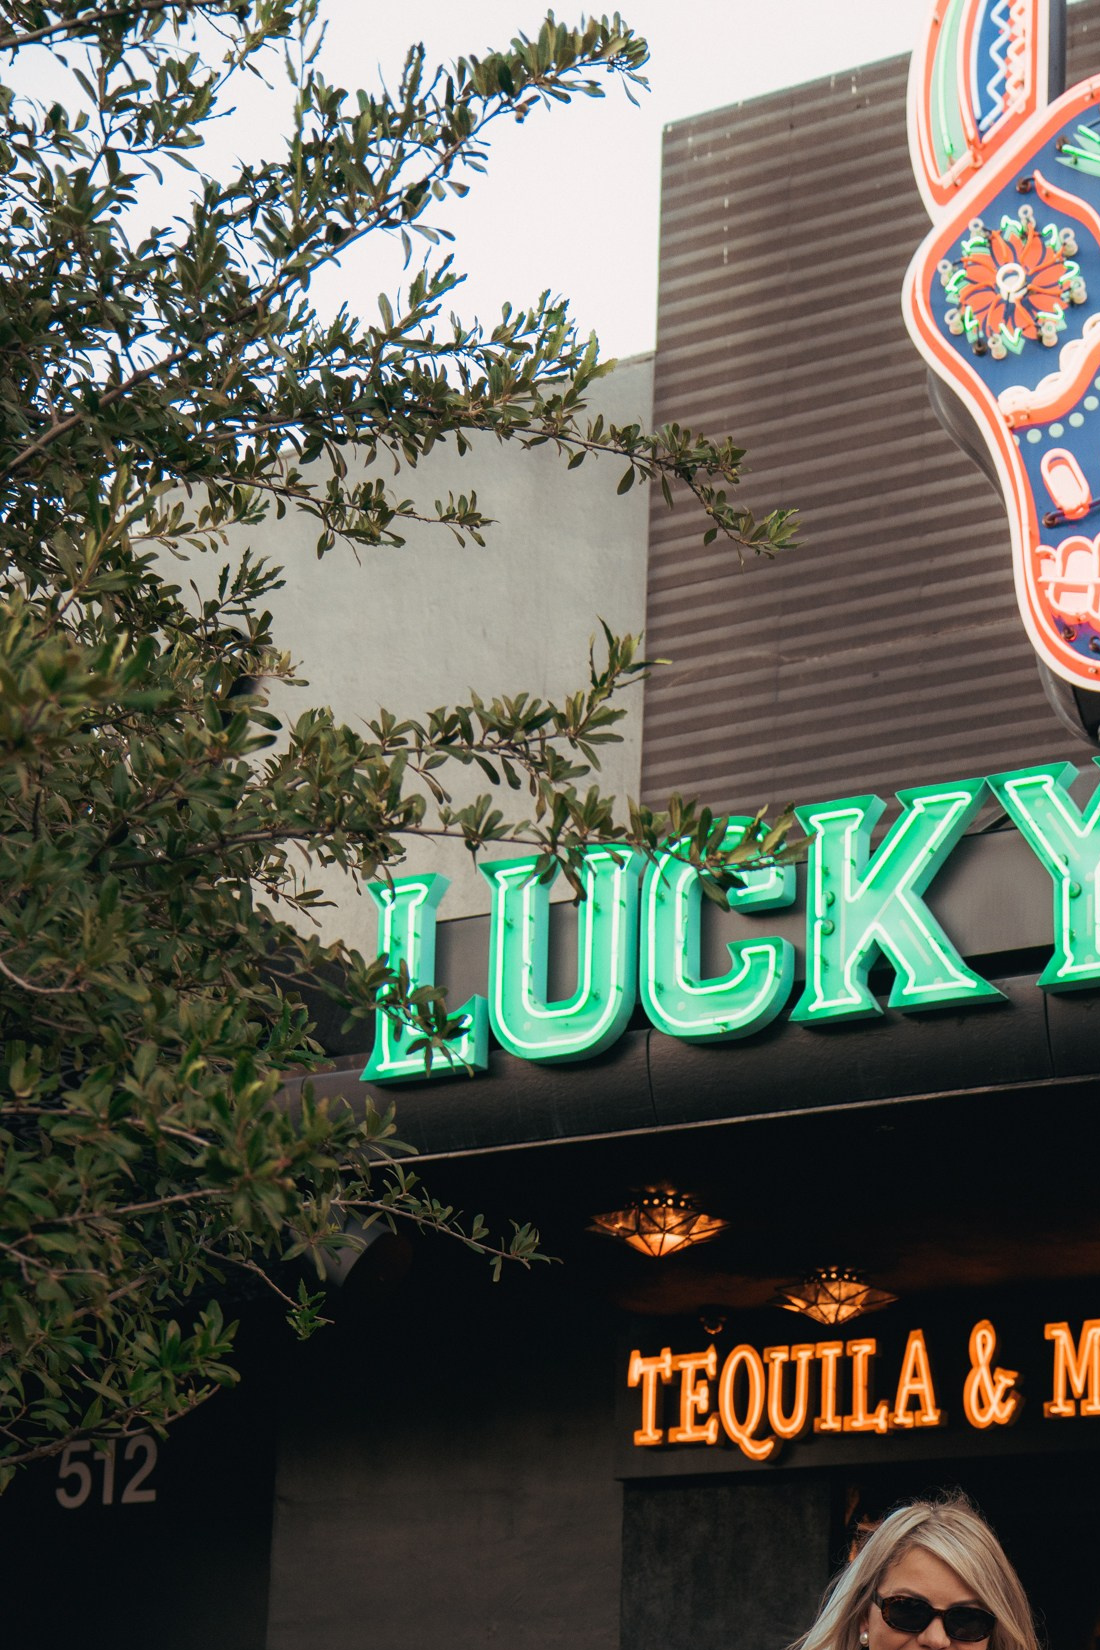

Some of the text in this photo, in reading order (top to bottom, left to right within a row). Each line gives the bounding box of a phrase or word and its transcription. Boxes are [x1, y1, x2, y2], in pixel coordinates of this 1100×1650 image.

[627, 1328, 946, 1462] TEQUILA
[963, 1319, 1026, 1430] &
[55, 1434, 158, 1509] 512
